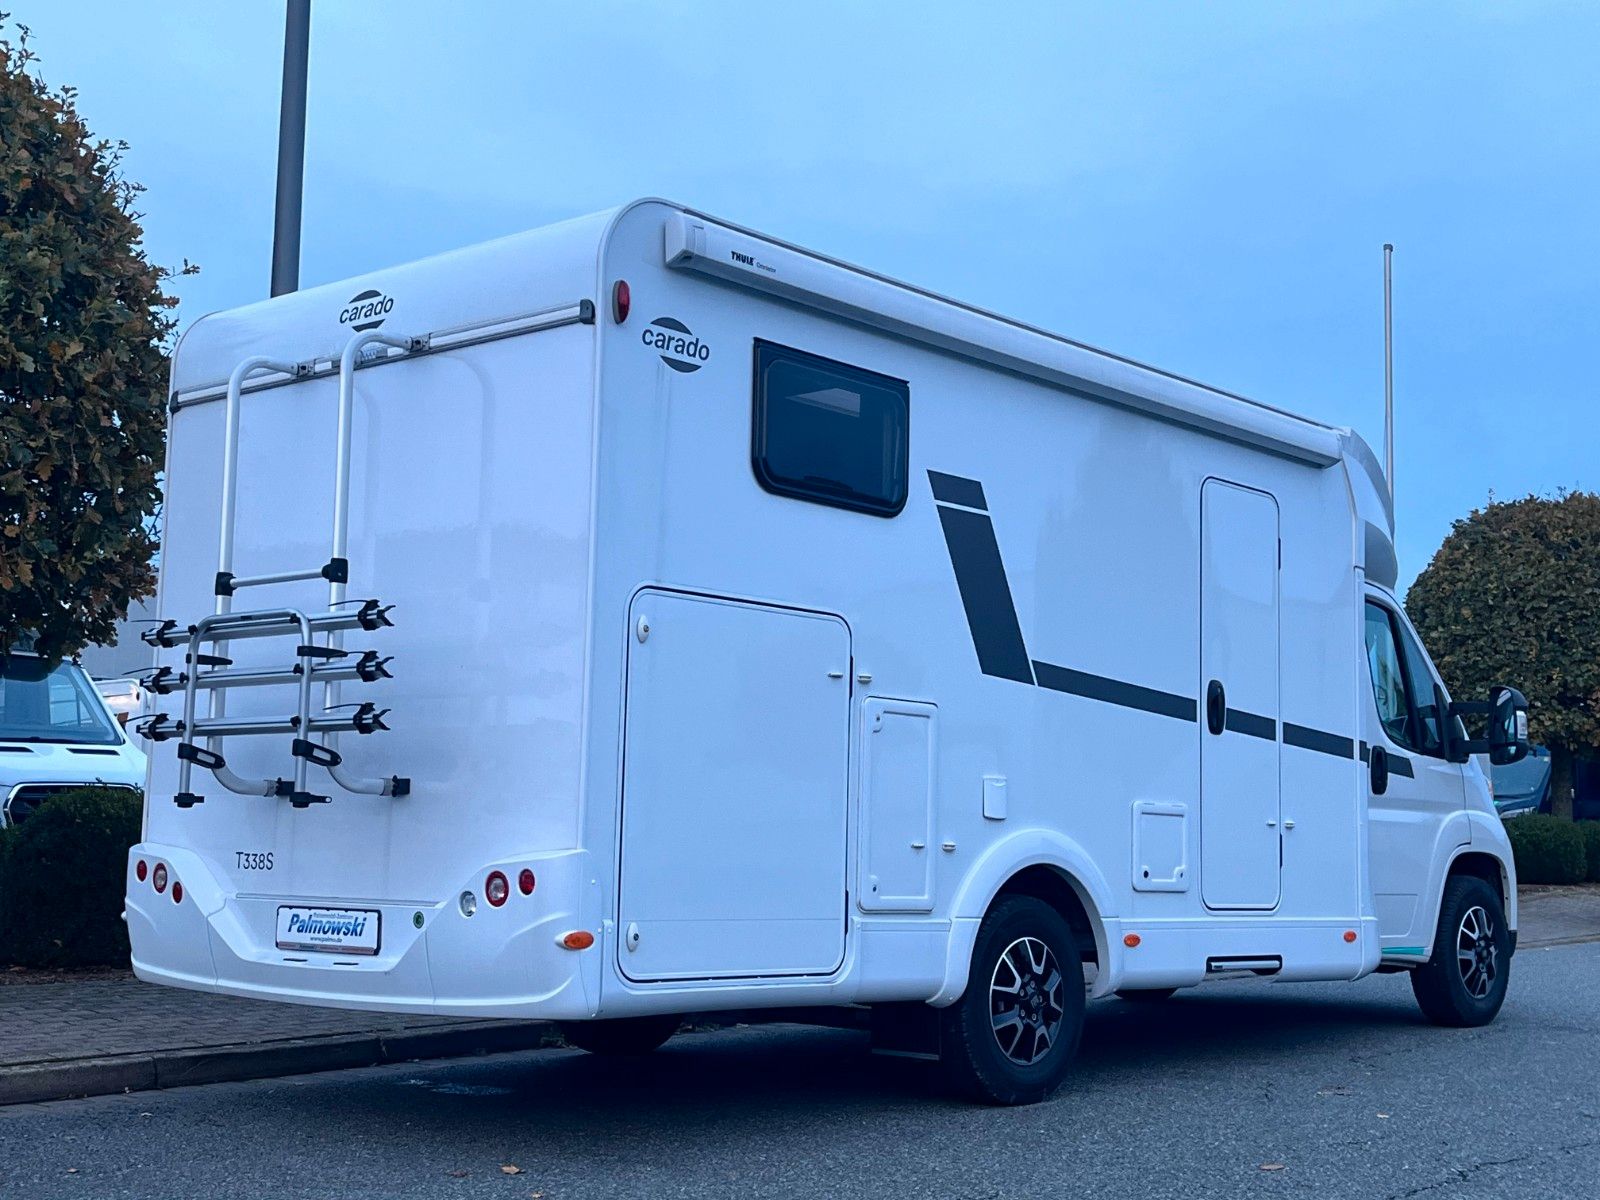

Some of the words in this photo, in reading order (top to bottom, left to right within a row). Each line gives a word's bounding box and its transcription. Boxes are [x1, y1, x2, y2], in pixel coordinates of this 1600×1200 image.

[731, 251, 754, 266] THULE
[339, 295, 394, 324] carado
[641, 328, 710, 361] carado
[235, 851, 274, 871] T338S
[287, 913, 367, 937] Palmowski
